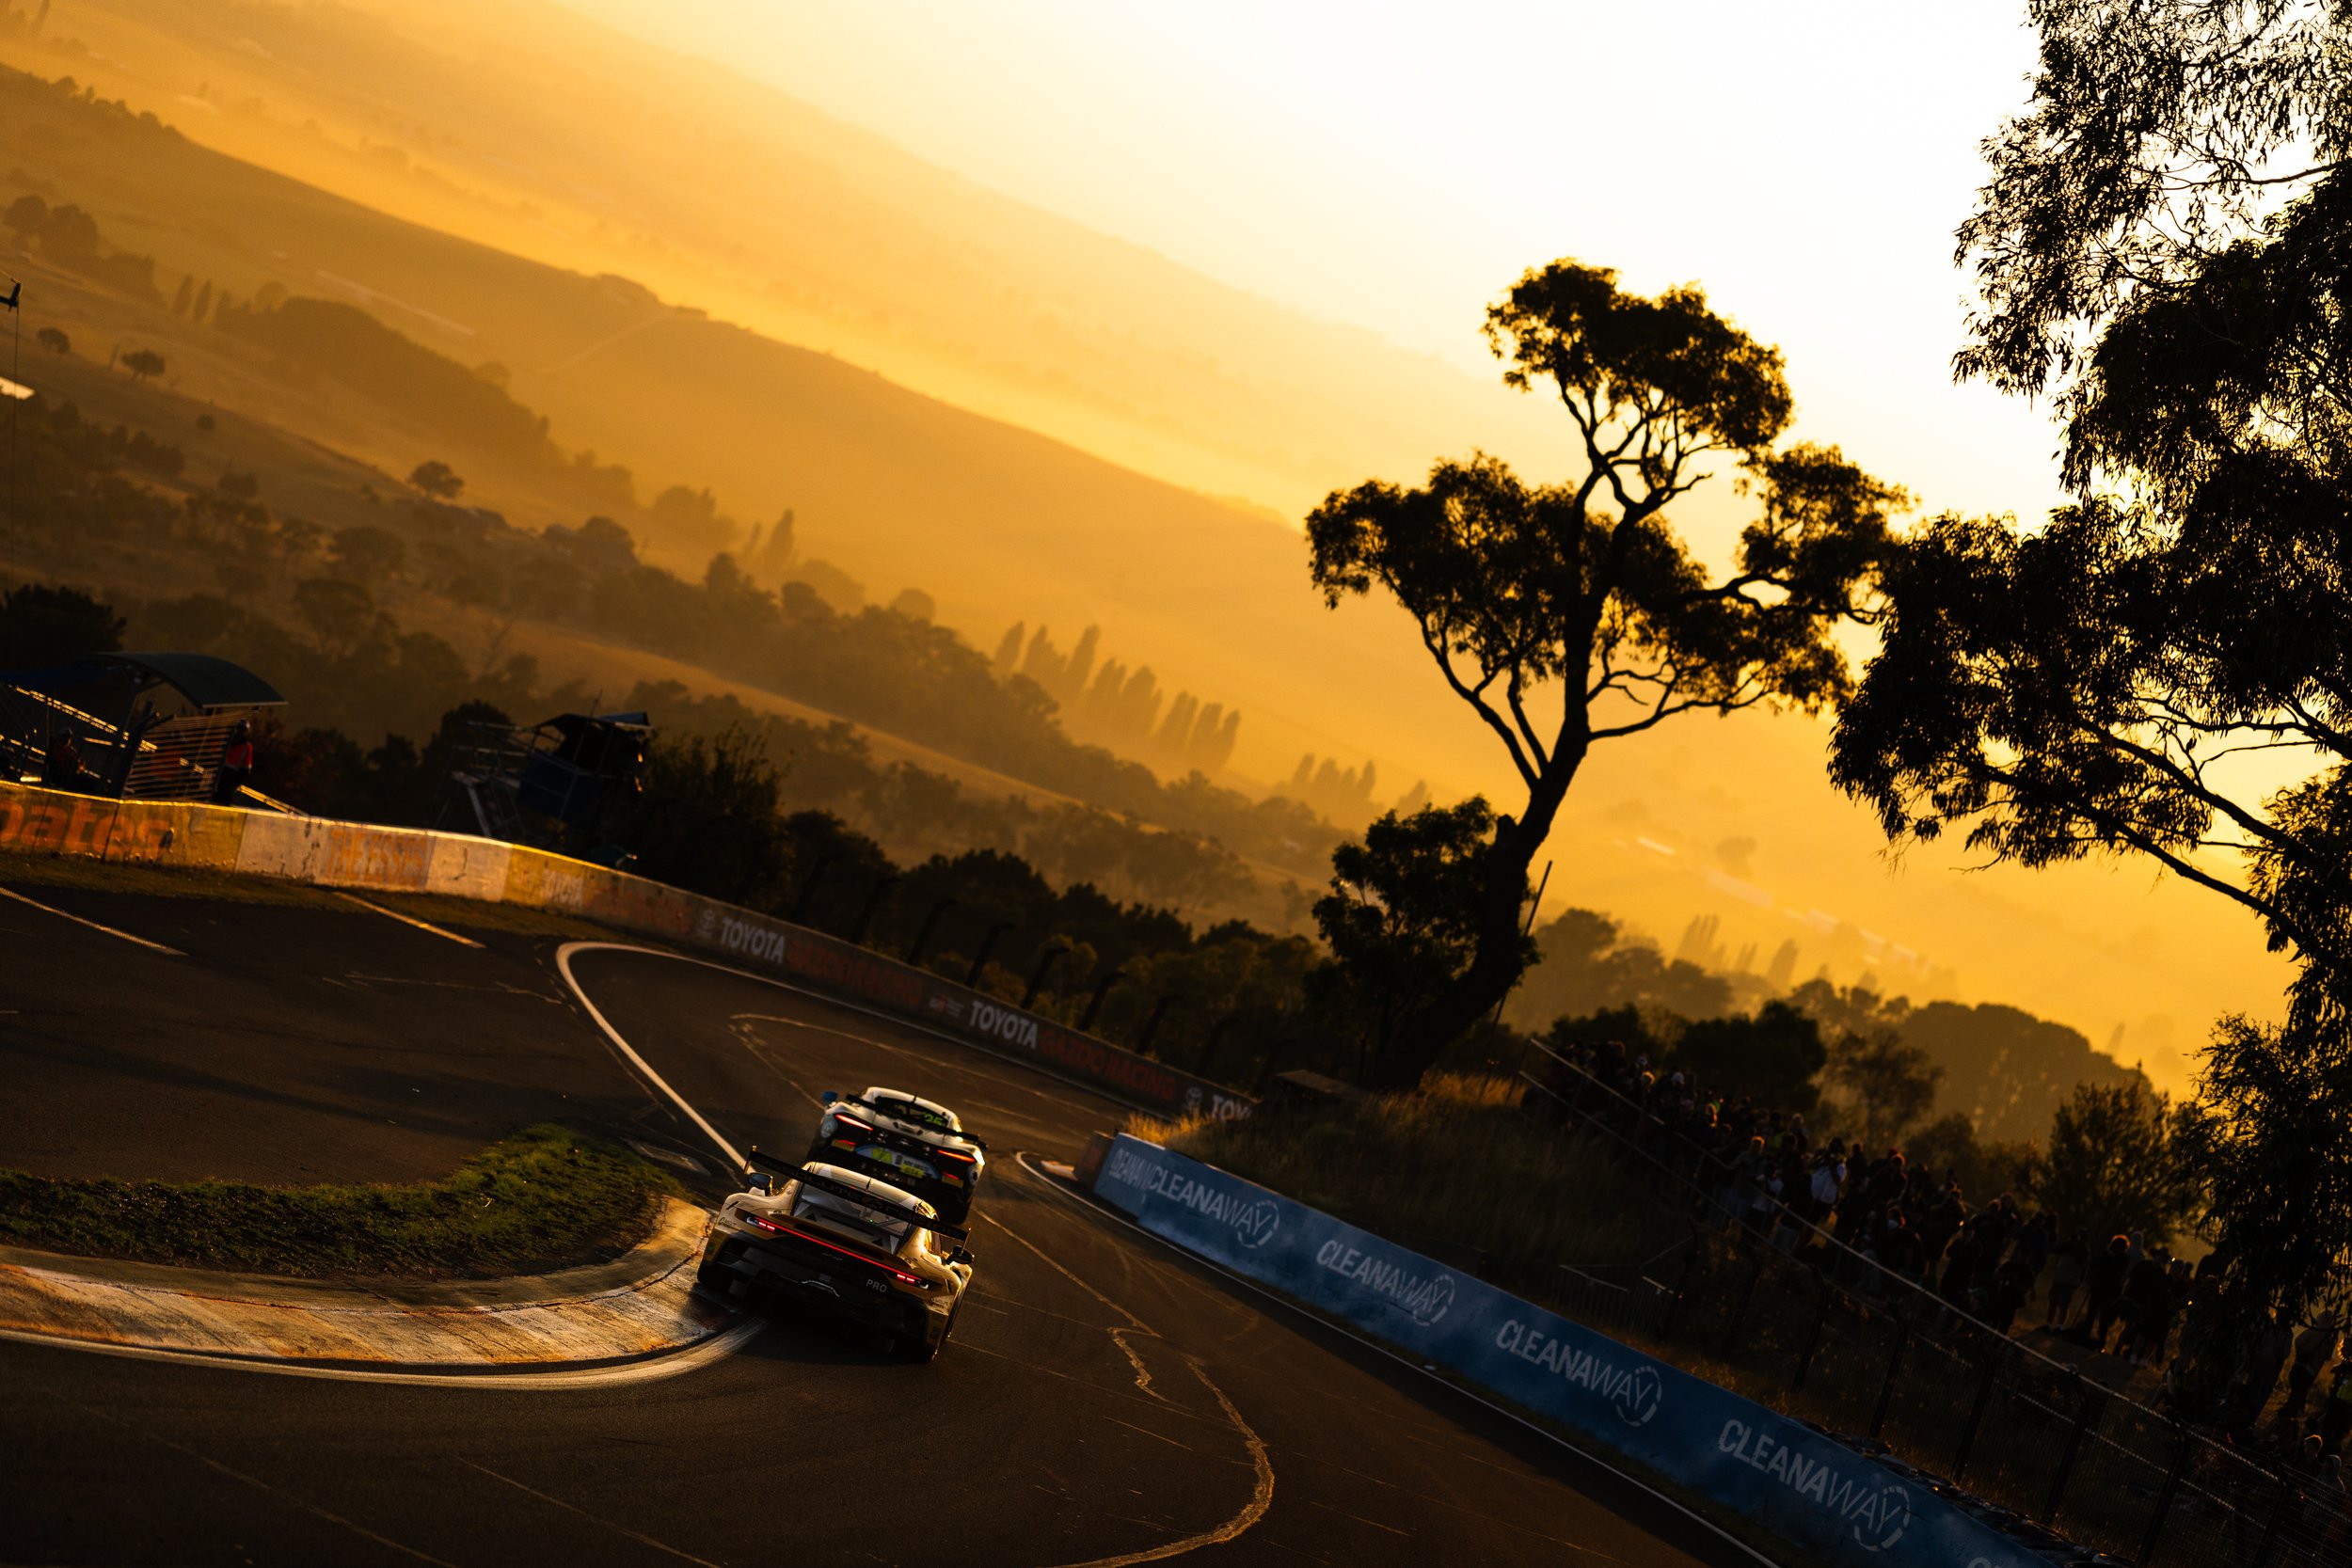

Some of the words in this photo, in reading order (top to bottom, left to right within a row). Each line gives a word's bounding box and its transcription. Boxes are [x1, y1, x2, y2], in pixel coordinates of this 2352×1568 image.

[721, 917, 786, 964] TOYOTA
[969, 999, 1040, 1049] TOYOTA
[1150, 1165, 1272, 1236] CLEANAWAY
[866, 1279, 887, 1293] PRO
[1317, 1240, 1448, 1316] CLEANAWAY
[1496, 1319, 1653, 1411] CLEANAWAY
[1717, 1419, 1902, 1534] CLEANAWAY
